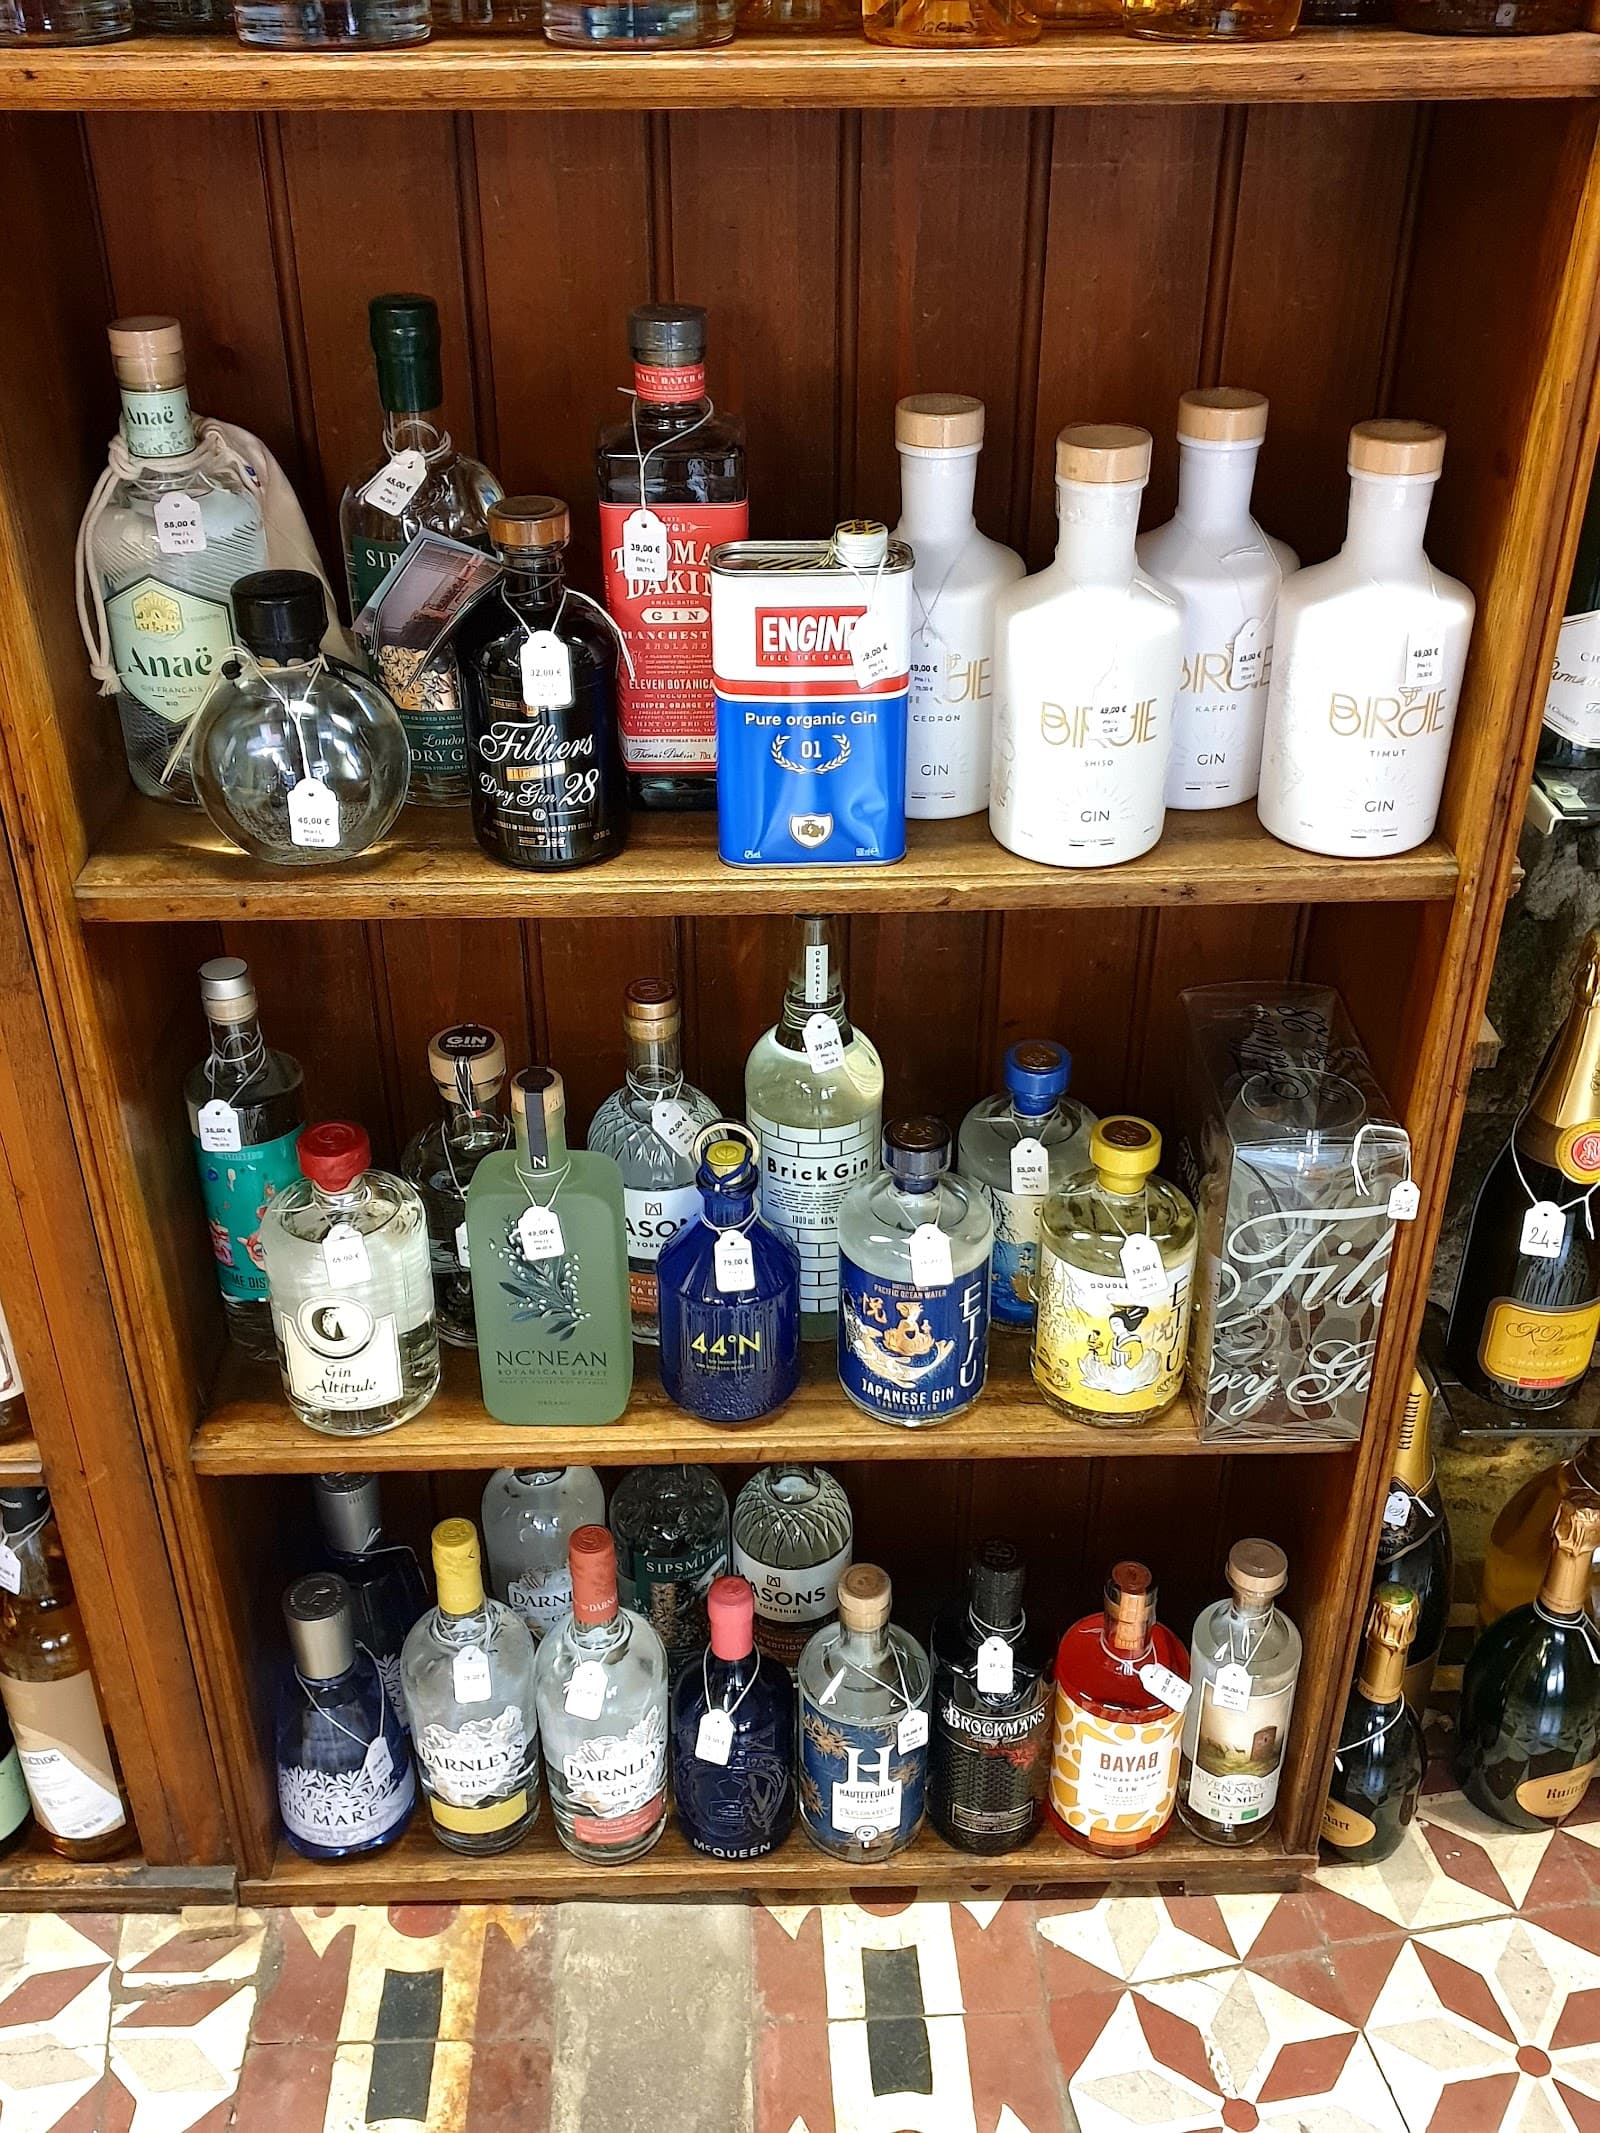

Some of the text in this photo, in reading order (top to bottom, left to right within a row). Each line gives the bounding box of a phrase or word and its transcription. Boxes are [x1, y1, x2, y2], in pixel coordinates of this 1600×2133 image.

[124, 405, 174, 427] Anaë
[163, 519, 196, 529] 55,00 €
[665, 523, 686, 532] 761
[631, 543, 653, 553] 39,00
[651, 611, 700, 621] GIN
[622, 631, 710, 640] MANCHEST
[128, 646, 213, 678] Anaë
[824, 653, 852, 661] DREA
[933, 665, 938, 673] €
[629, 679, 714, 690] ELEVEN BOTANICA
[1195, 704, 1237, 712] KAFFIR
[745, 711, 877, 728] Pure organic Gin
[479, 721, 593, 762] Filliers
[801, 741, 822, 758] 01
[1370, 749, 1407, 757] TIMUT
[411, 750, 445, 764] DRY
[1197, 753, 1226, 765] GIN
[920, 764, 949, 776] GIN
[480, 772, 515, 806] Dry
[516, 782, 557, 806] Gin
[559, 768, 599, 806] 28
[1364, 800, 1395, 812] GIN
[1080, 810, 1111, 823] GIN
[447, 1035, 487, 1045] GIN
[533, 1155, 548, 1169] N
[625, 1218, 690, 1238] ASO
[1215, 1204, 1396, 1328] Fil
[248, 1274, 267, 1288] DIS
[691, 1331, 761, 1357] 44°N
[496, 1350, 608, 1367] NC'NEAN
[325, 1365, 351, 1379] Gin
[498, 1368, 608, 1377] BOTANICAL SPIRIT
[1286, 1339, 1376, 1405] Gi
[862, 1378, 955, 1405] JAPANESE GIN
[646, 1541, 724, 1574] SIPSMITH
[737, 1563, 826, 1606] ASONS
[513, 1590, 573, 1608] DARN
[949, 1706, 1046, 1737] BROCKMANS
[1100, 1752, 1159, 1773] BAYAB
[460, 1780, 488, 1789] GIN
[611, 1784, 639, 1797] GIN
[839, 1786, 895, 1799] HAUTEFEUILLE
[313, 1803, 379, 1826] MARE
[693, 1838, 771, 1859] McQUEEN
